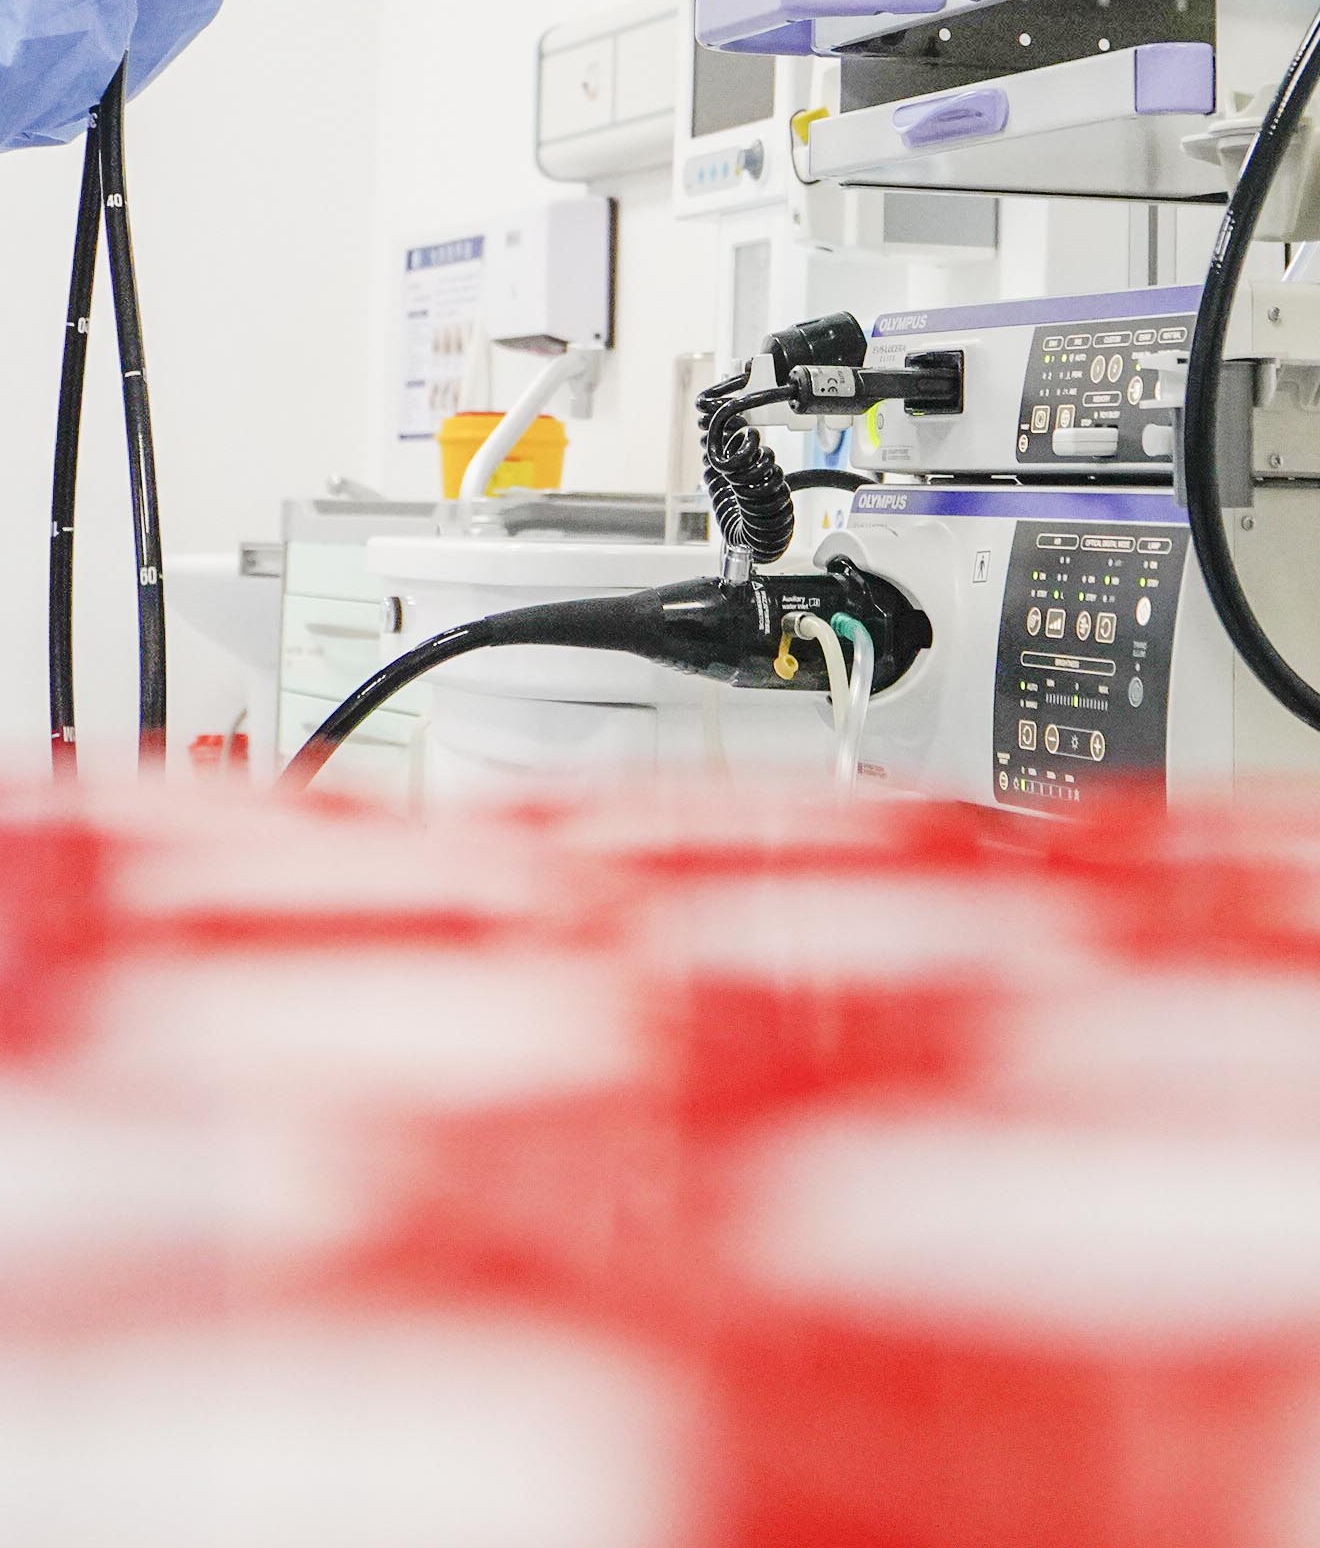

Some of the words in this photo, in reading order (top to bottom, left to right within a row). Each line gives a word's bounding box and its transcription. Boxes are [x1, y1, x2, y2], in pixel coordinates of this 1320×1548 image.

[107, 193, 123, 208] 40
[881, 314, 928, 331] OLYMPUS
[858, 495, 908, 510] OLYMPUS
[140, 566, 157, 585] 60
